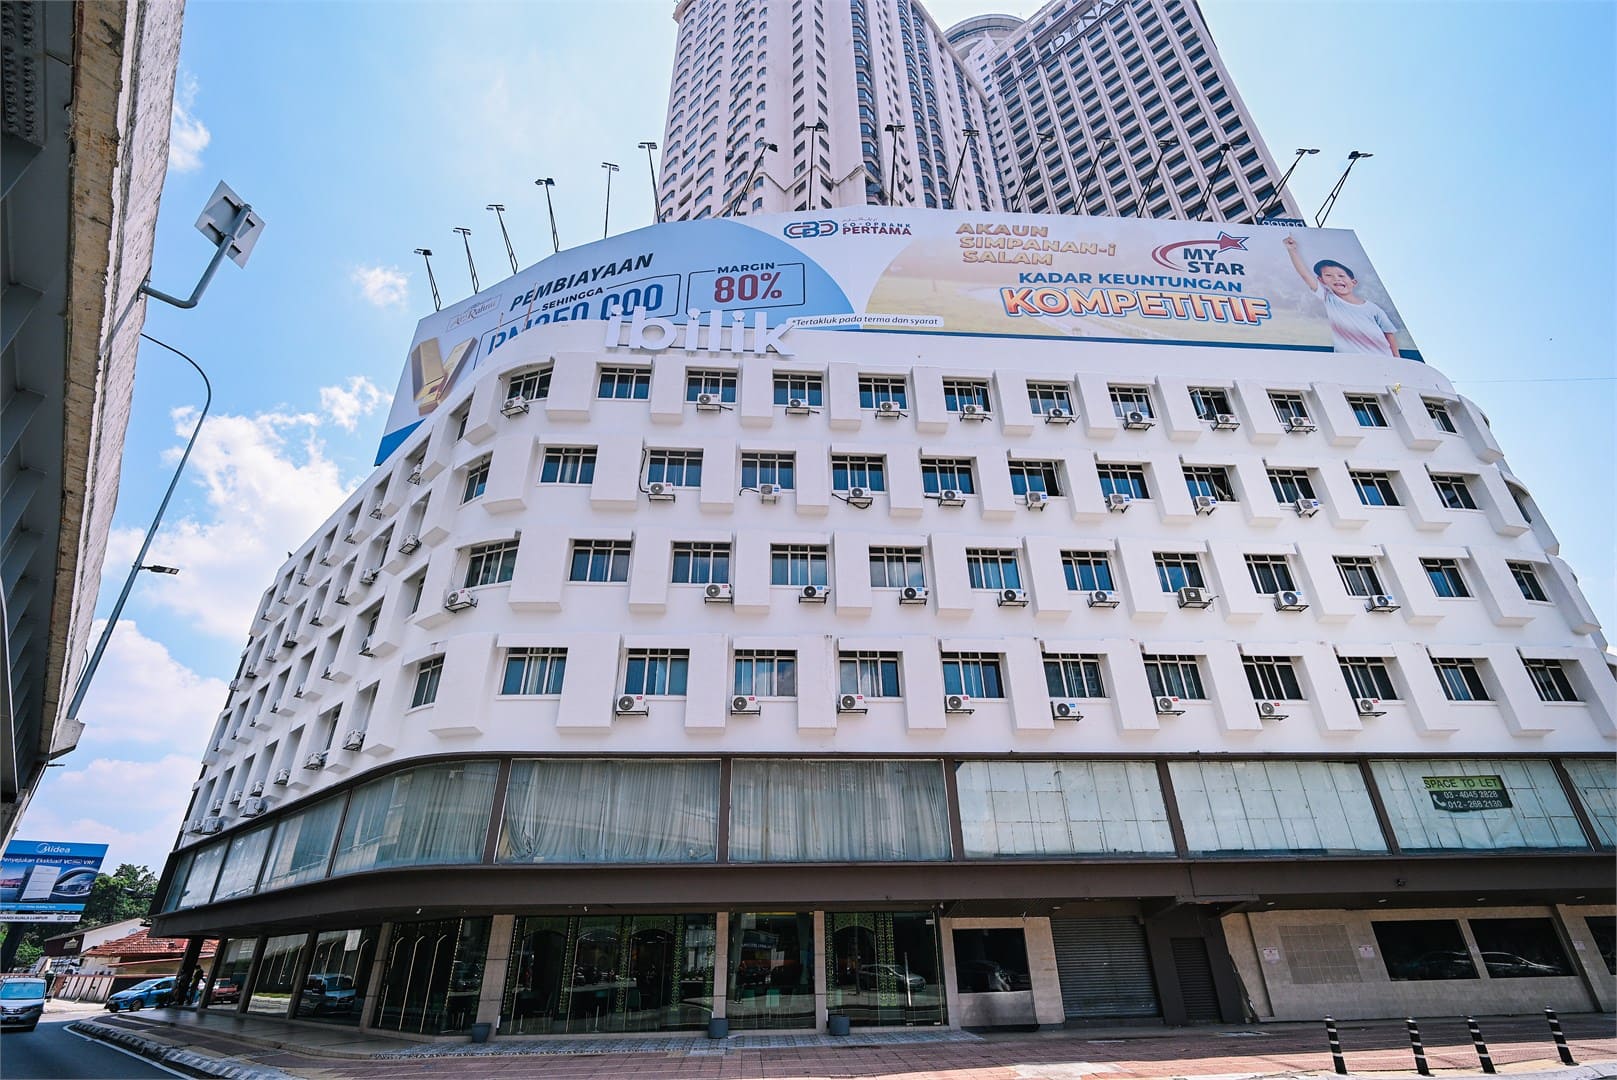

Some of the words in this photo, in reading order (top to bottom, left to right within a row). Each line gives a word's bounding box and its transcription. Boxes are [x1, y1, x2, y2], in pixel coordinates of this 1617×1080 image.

[1052, 0, 1121, 51] DYNA
[842, 226, 912, 236] PERTAMA
[955, 223, 1049, 238] AKAUN
[959, 236, 1117, 256] SIMPANAN-i
[1183, 247, 1218, 261] MY
[963, 250, 1054, 266] SALAM
[717, 262, 775, 274] MARGIN
[1188, 261, 1246, 276] STAR
[509, 252, 654, 312] PEMBIAYAAN
[713, 271, 783, 303] 80%
[1019, 272, 1092, 285] KADAR
[1098, 273, 1242, 293] KEUNTUNGAN
[541, 286, 604, 312] SEHINGGA
[1000, 286, 1272, 326] KOMPETITIF
[838, 315, 862, 325] pada
[864, 316, 890, 324] terma
[891, 316, 909, 324] dan
[909, 318, 938, 326] syarat
[604, 304, 797, 356] ibilik
[1423, 778, 1458, 789] SPACE
[1460, 778, 1476, 788] TO
[1479, 778, 1498, 788] LET
[36, 843, 70, 854] Midea
